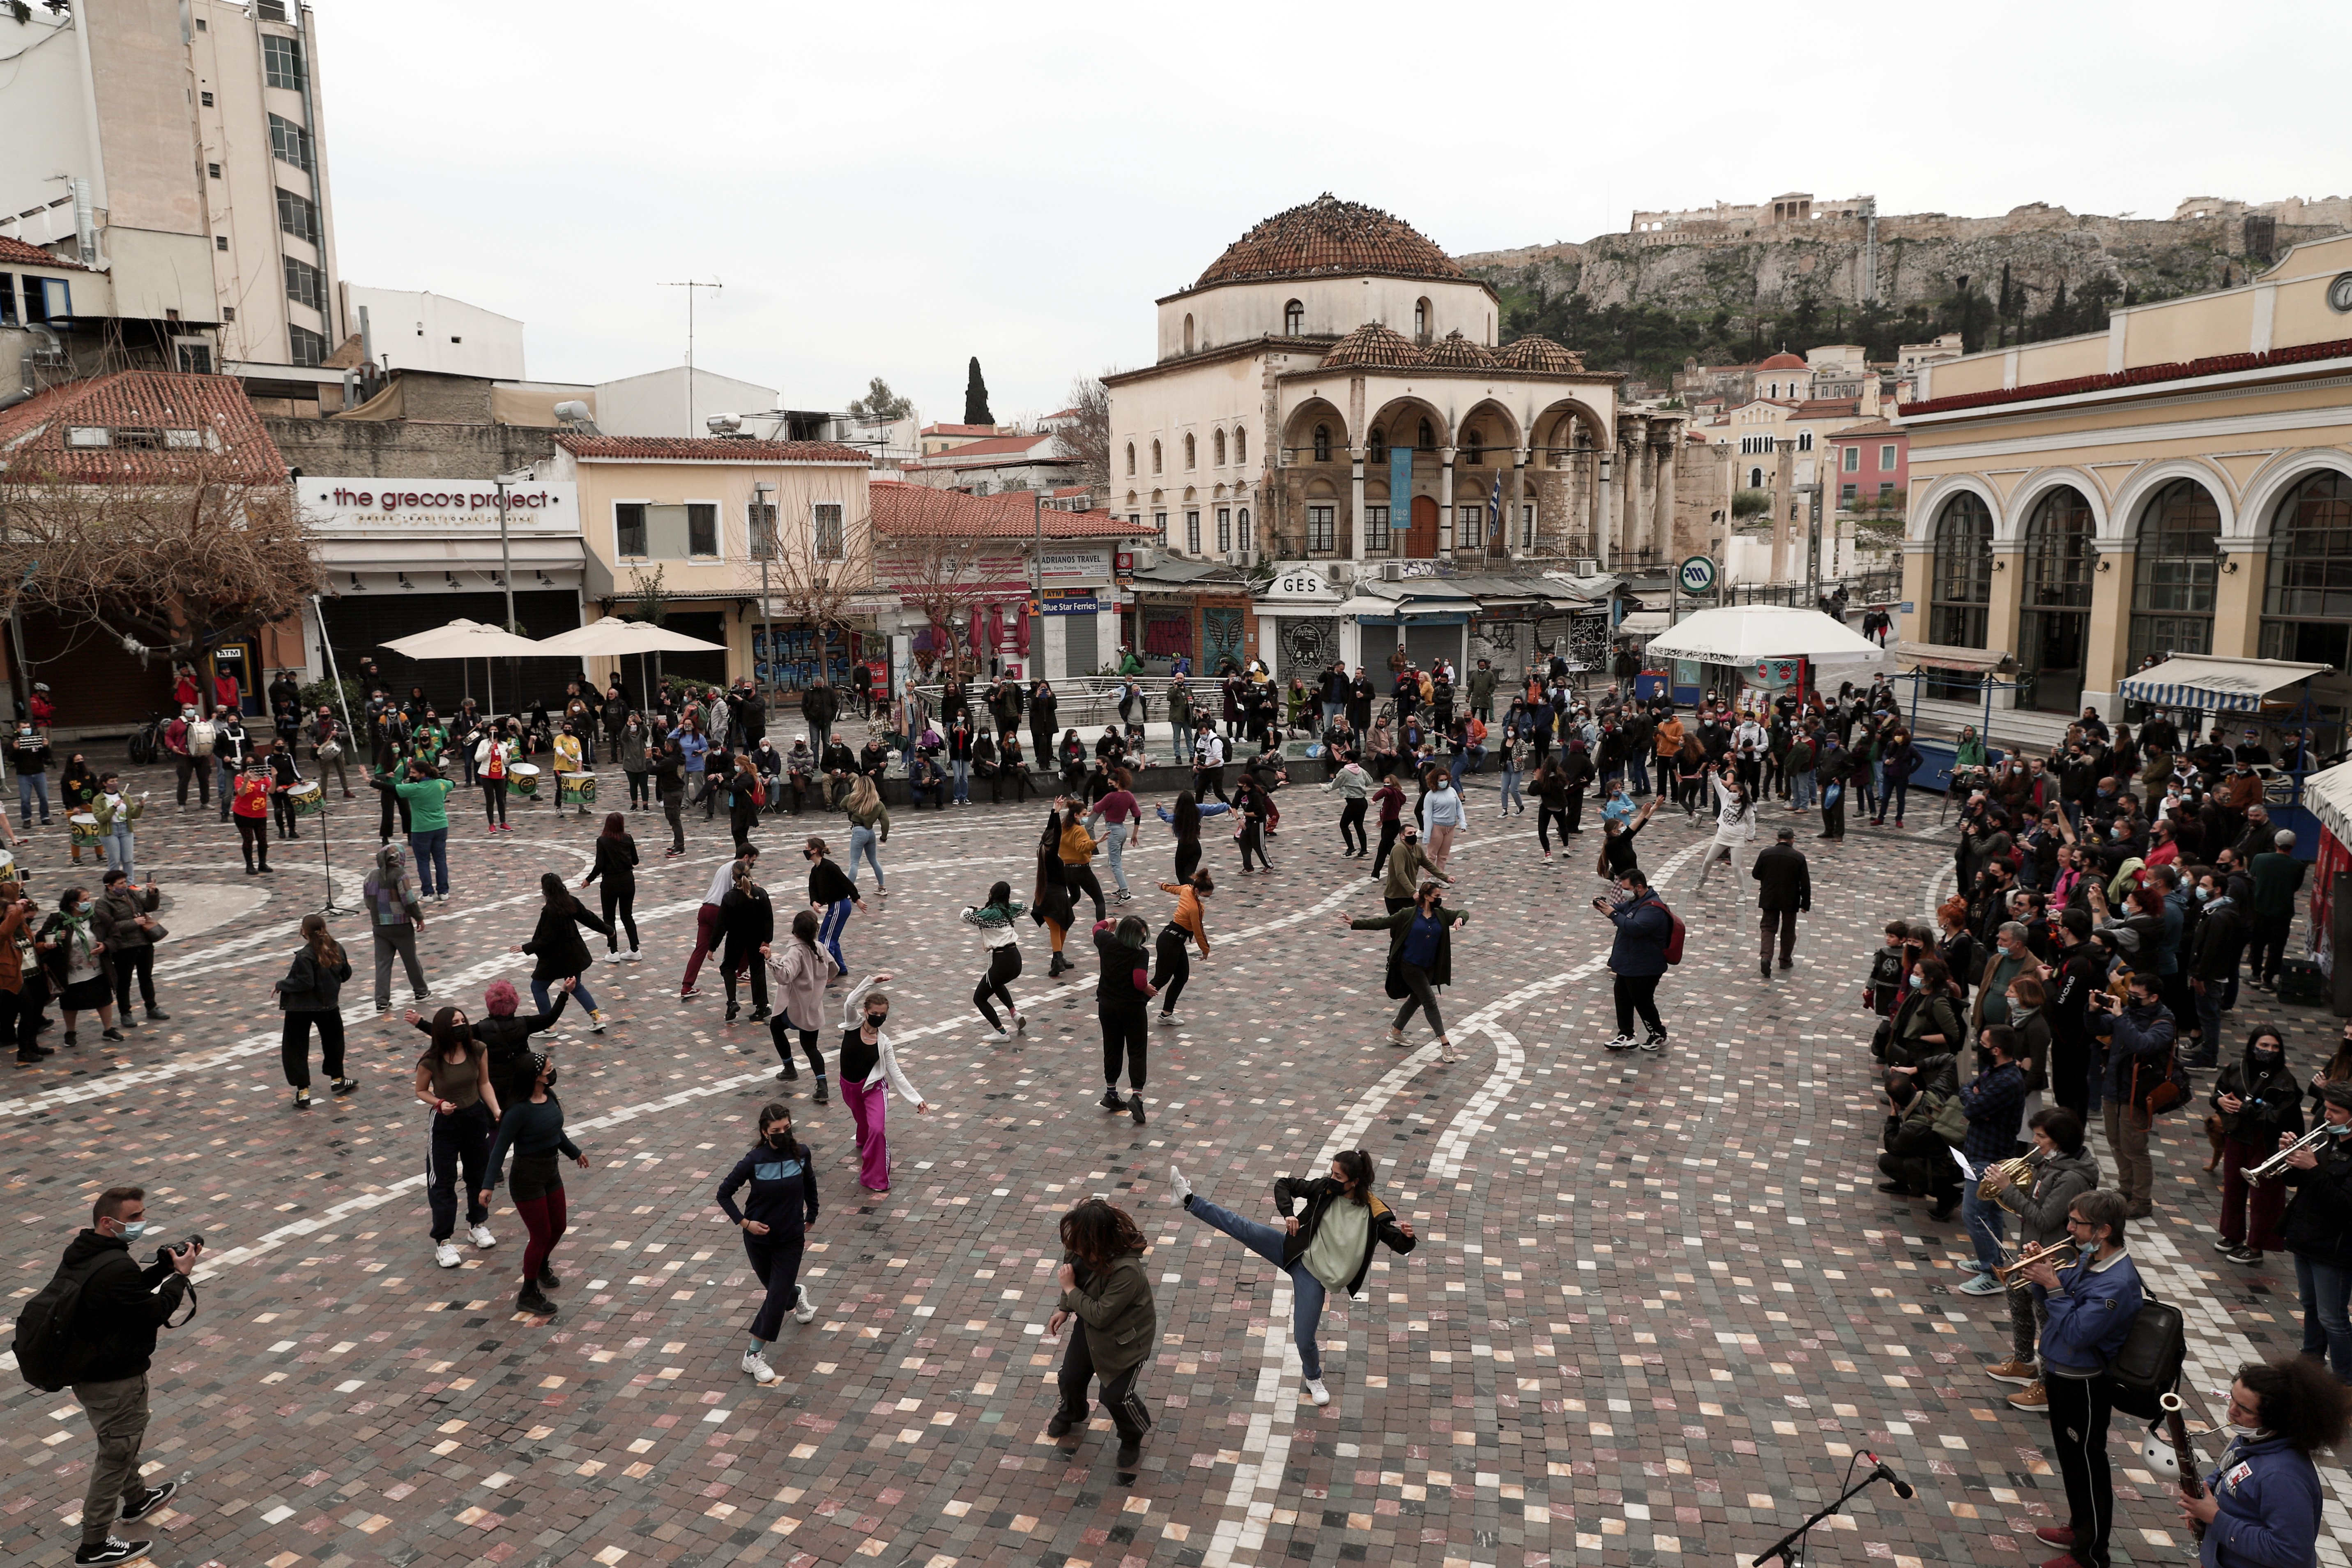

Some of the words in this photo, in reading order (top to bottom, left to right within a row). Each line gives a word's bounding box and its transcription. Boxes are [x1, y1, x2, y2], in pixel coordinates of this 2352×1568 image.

[333, 488, 373, 506] the
[381, 493, 465, 511] greco's
[471, 490, 548, 511] project
[1284, 579, 1316, 592] GES
[1059, 603, 1072, 611] Star
[1073, 602, 1096, 610] Ferries
[2057, 976, 2076, 1004] GIVOVA
